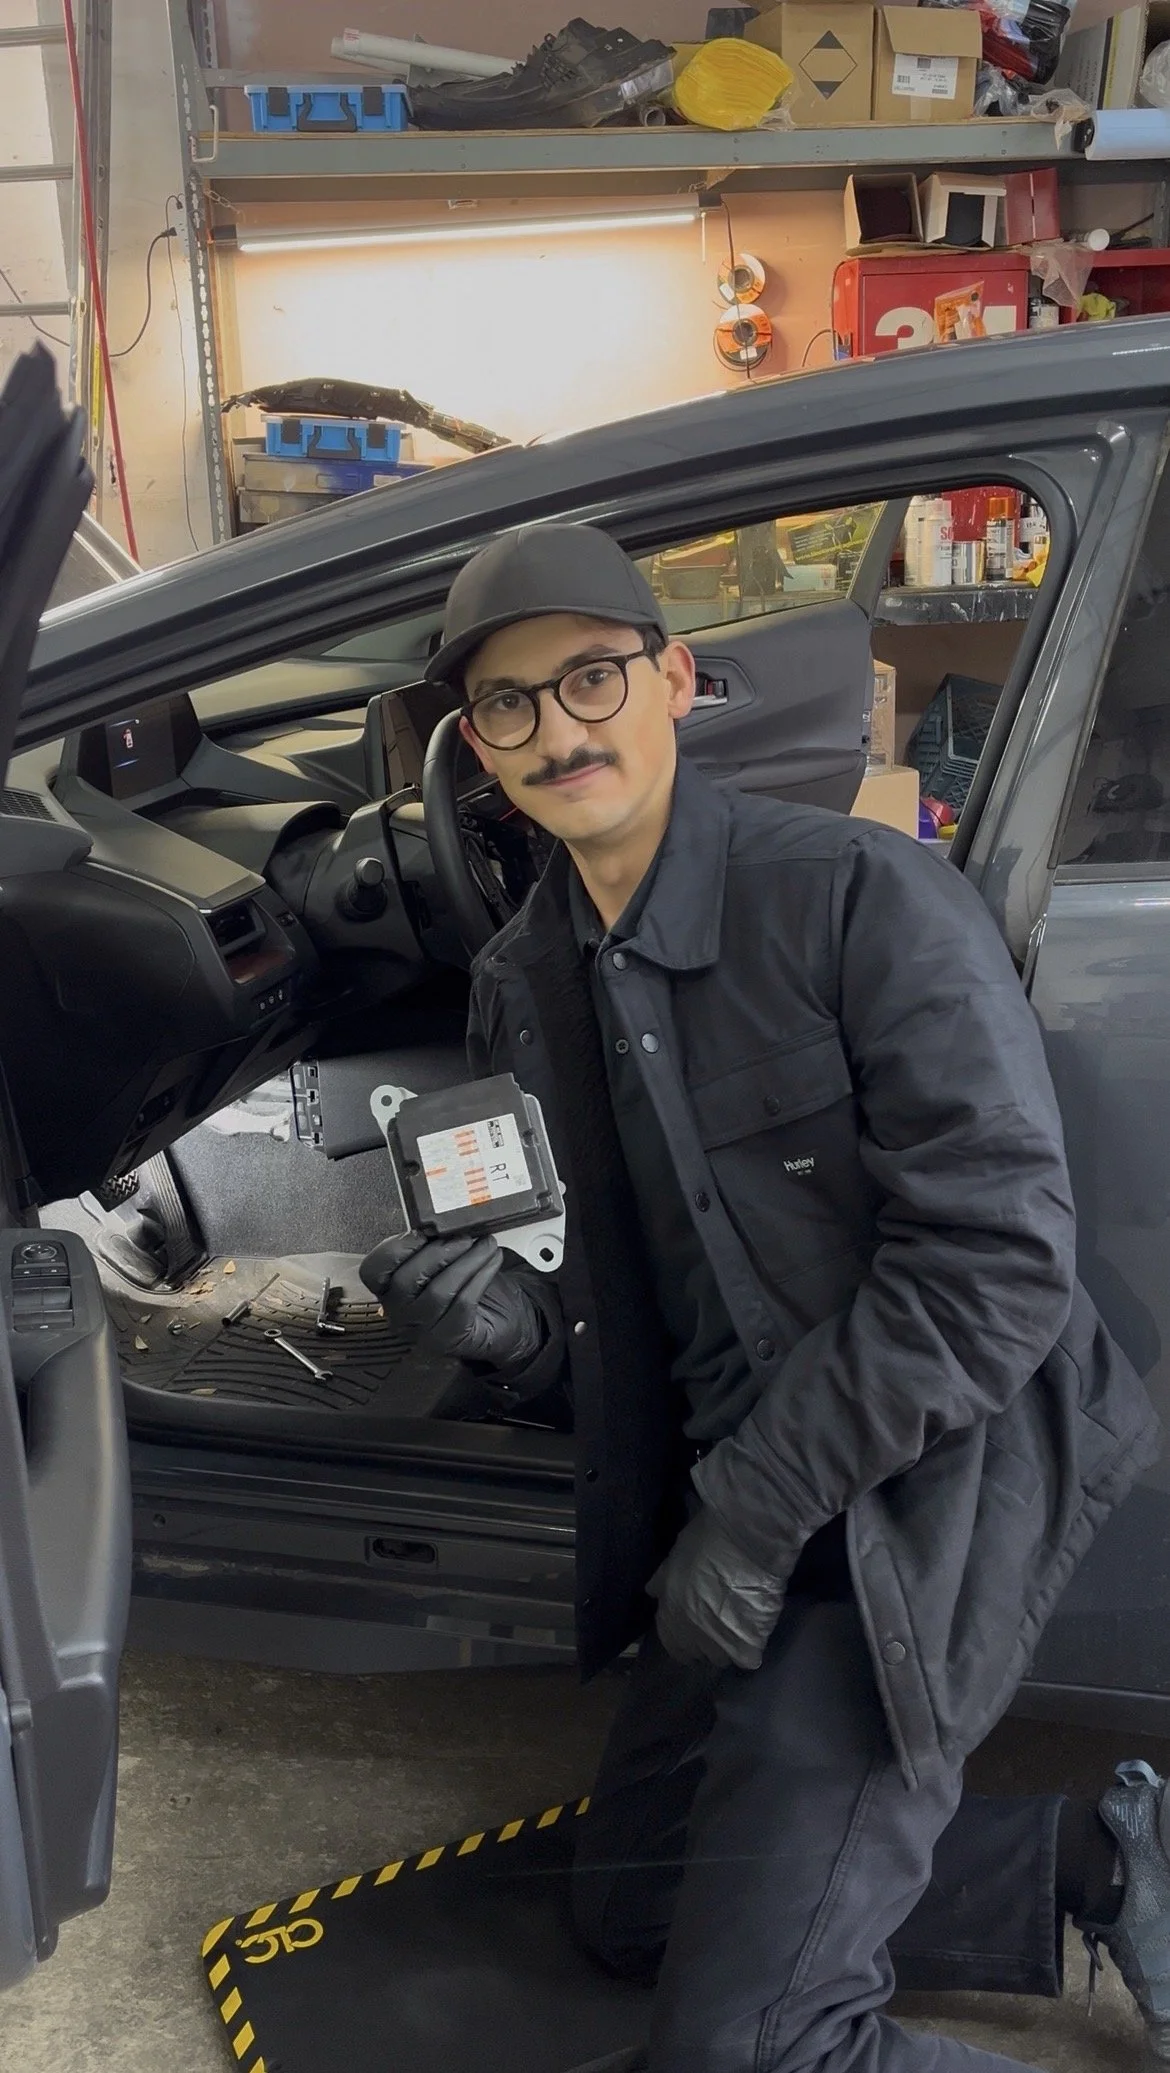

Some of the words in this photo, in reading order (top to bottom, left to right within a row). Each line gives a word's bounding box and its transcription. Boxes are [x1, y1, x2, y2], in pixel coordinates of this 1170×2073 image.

[489, 1163, 510, 1181] RT
[783, 1157, 815, 1172] Hurley
[240, 1918, 324, 1964] CLC
